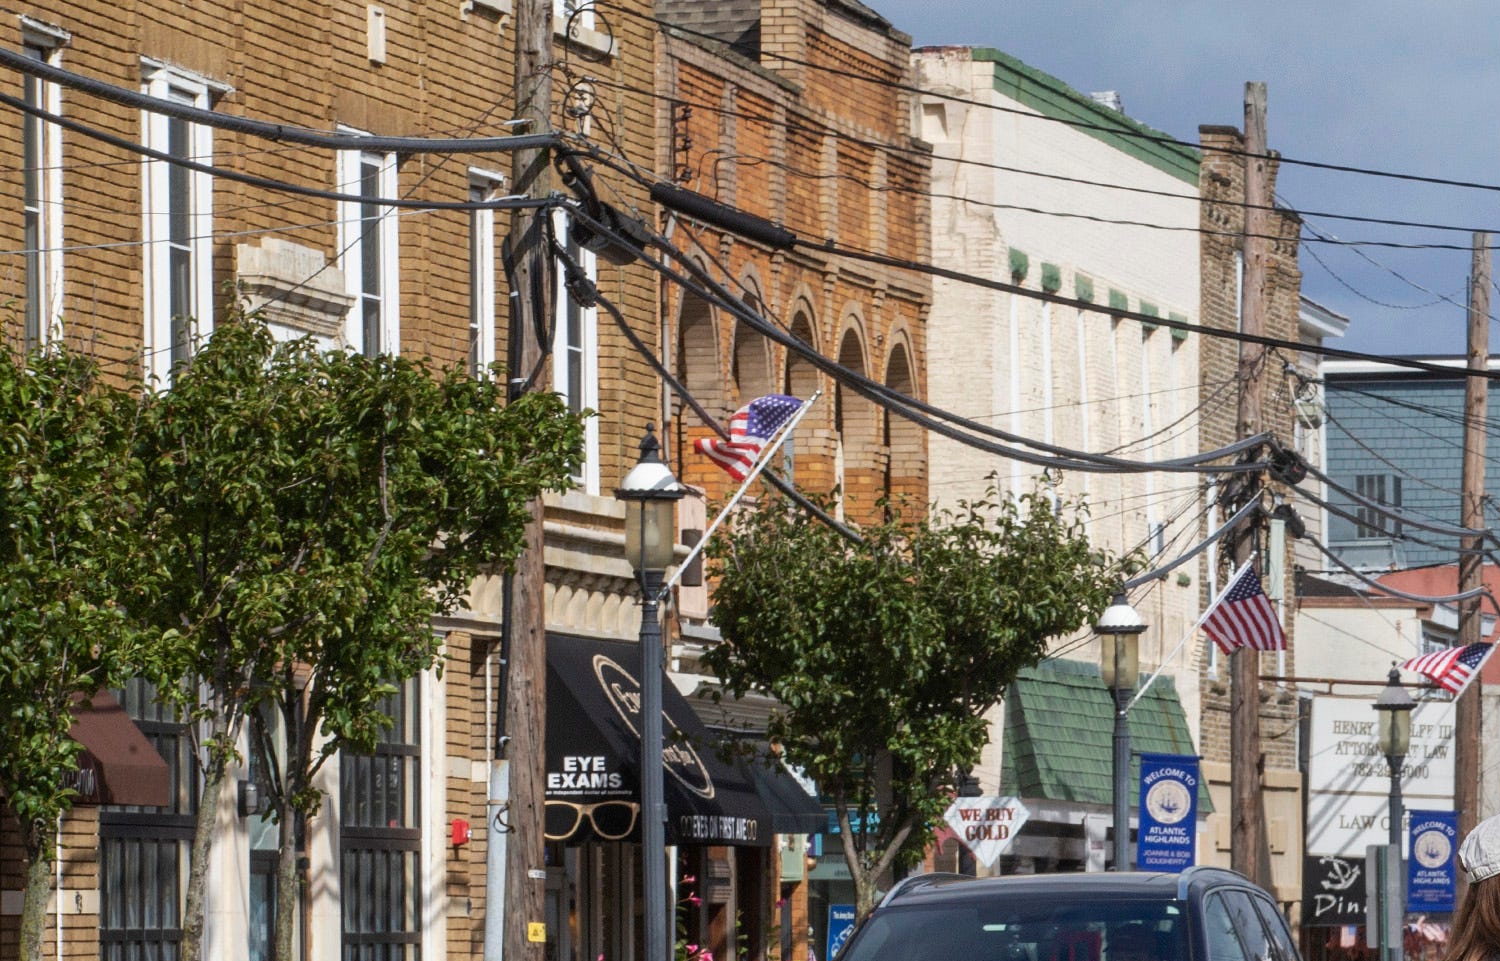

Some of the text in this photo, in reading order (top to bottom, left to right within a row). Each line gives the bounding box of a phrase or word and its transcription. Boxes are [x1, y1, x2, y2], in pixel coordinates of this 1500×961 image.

[1332, 719, 1376, 736] HENRY
[1335, 740, 1385, 757] ATTORN
[1423, 744, 1450, 760] LAW
[563, 756, 606, 771] EYE
[547, 772, 622, 789] EXAMS
[1144, 767, 1196, 786] WELCOME TO
[958, 807, 1016, 822] WE BUY
[1339, 814, 1377, 829] LAW
[693, 815, 748, 841] EYES ON FIRST AVE
[965, 824, 1009, 841] GOLD
[1149, 826, 1187, 836] ATLANTIC
[1412, 820, 1446, 837] WELCOME
[1446, 825, 1456, 837] TO
[1144, 835, 1191, 845] HIGHLANDS
[1412, 877, 1451, 885] HIGHLANDS
[1416, 870, 1448, 878] ATLANTIC
[1313, 893, 1368, 918] Din
